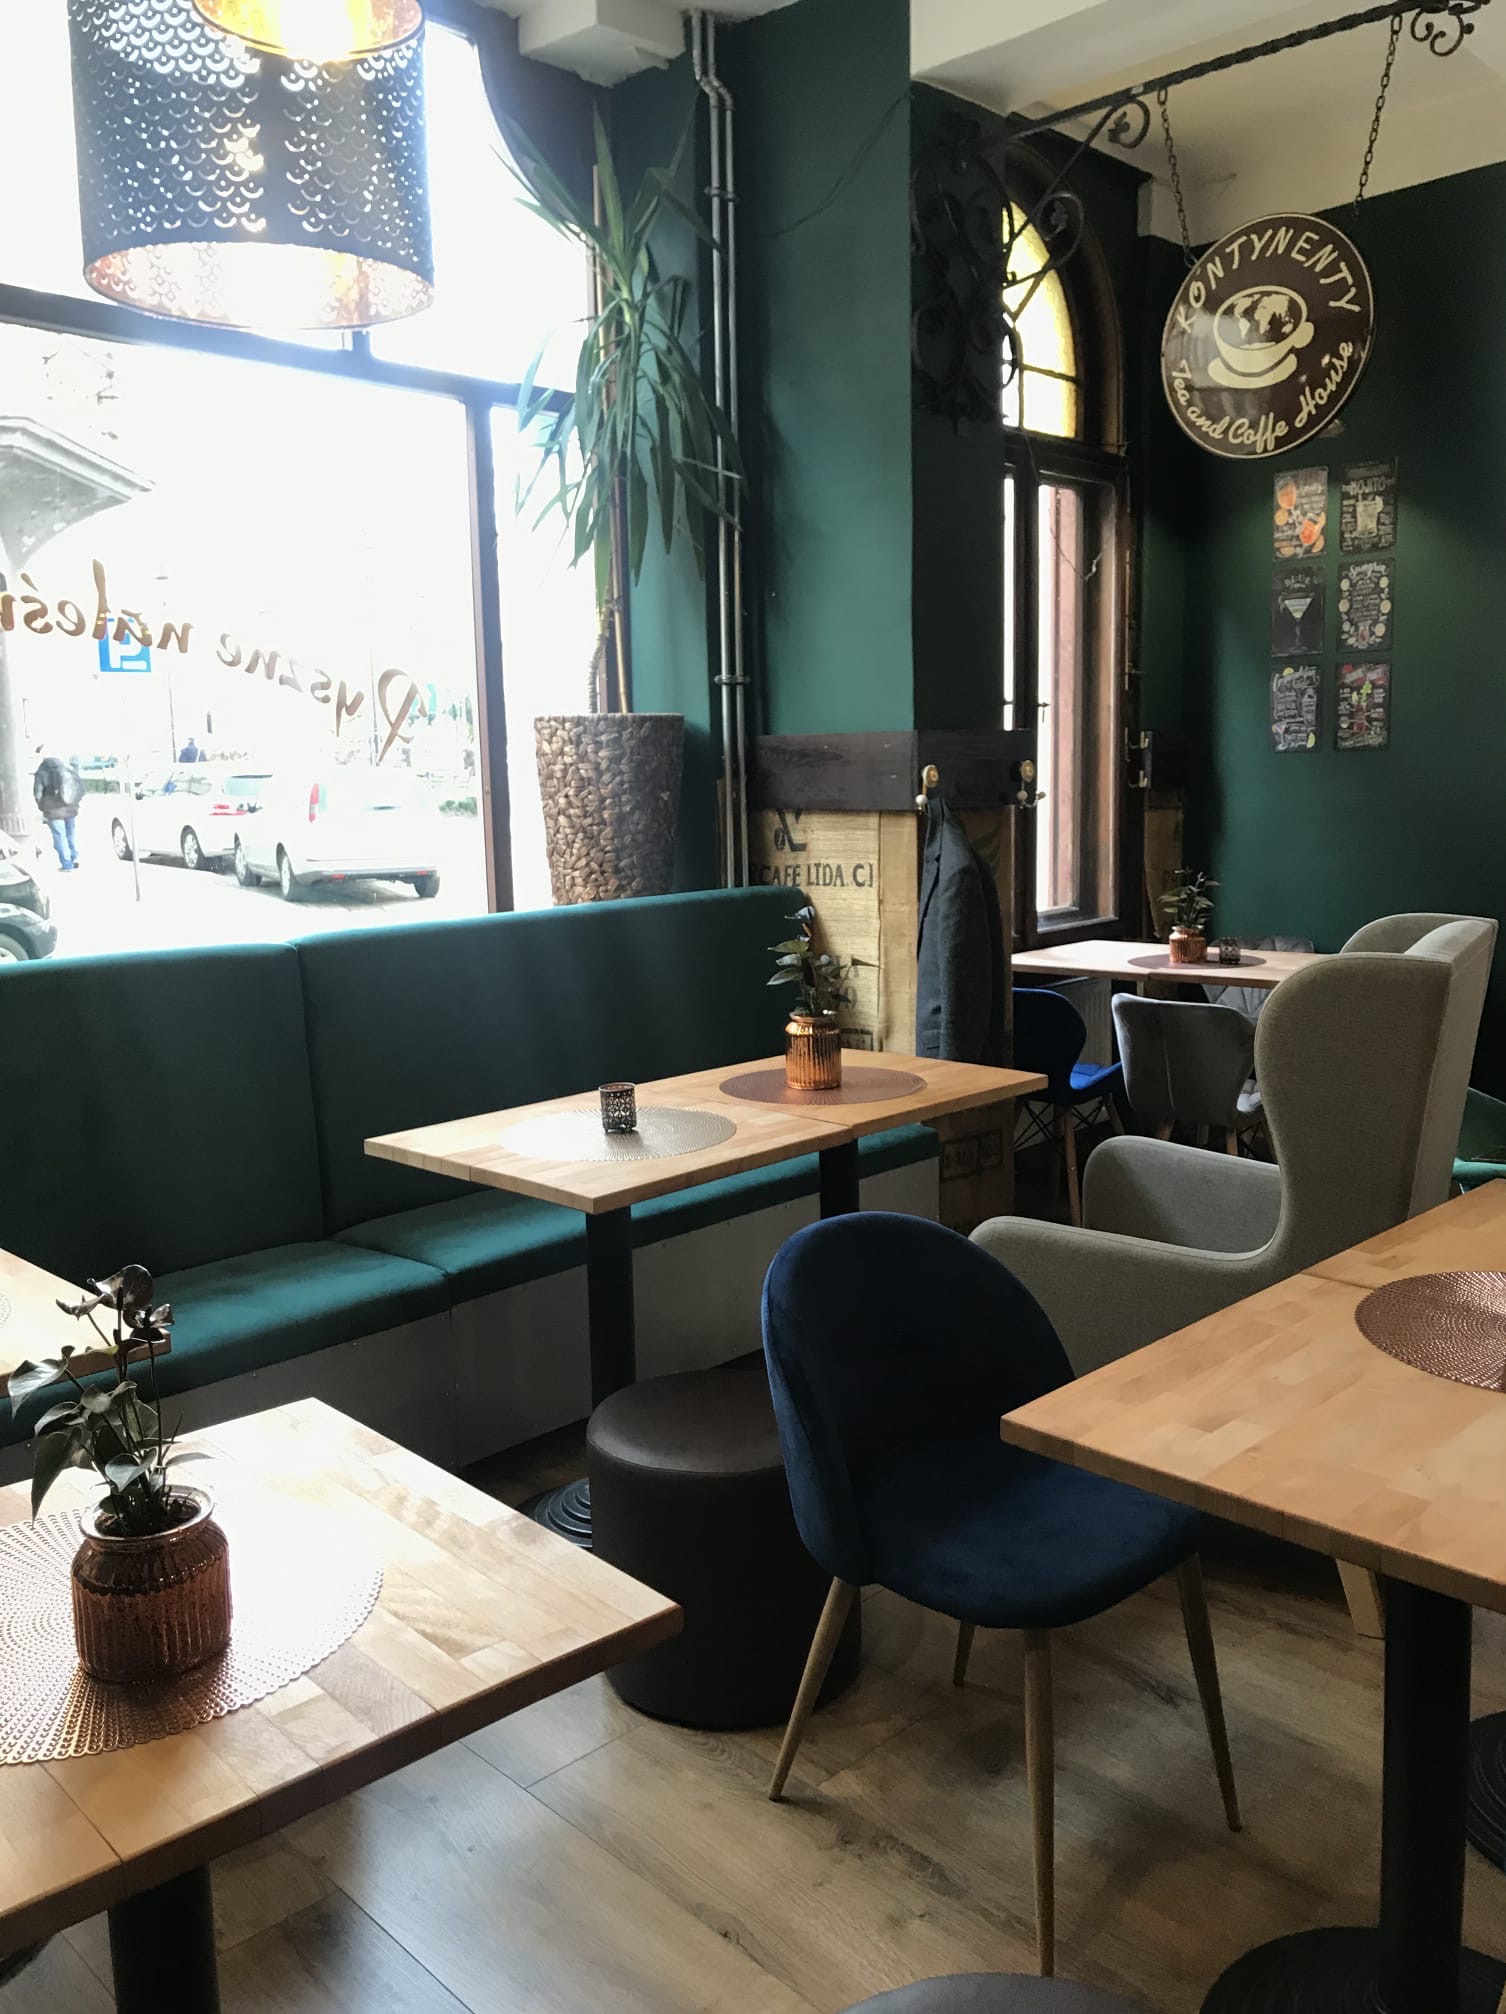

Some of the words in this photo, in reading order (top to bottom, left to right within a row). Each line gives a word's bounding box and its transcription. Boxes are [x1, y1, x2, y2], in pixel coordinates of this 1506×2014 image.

[1177, 226, 1361, 333] KONTYNENTY
[1171, 359, 1192, 406] Tea
[1188, 408, 1225, 440] and
[1228, 412, 1289, 454] Coffe
[1295, 340, 1353, 428] House
